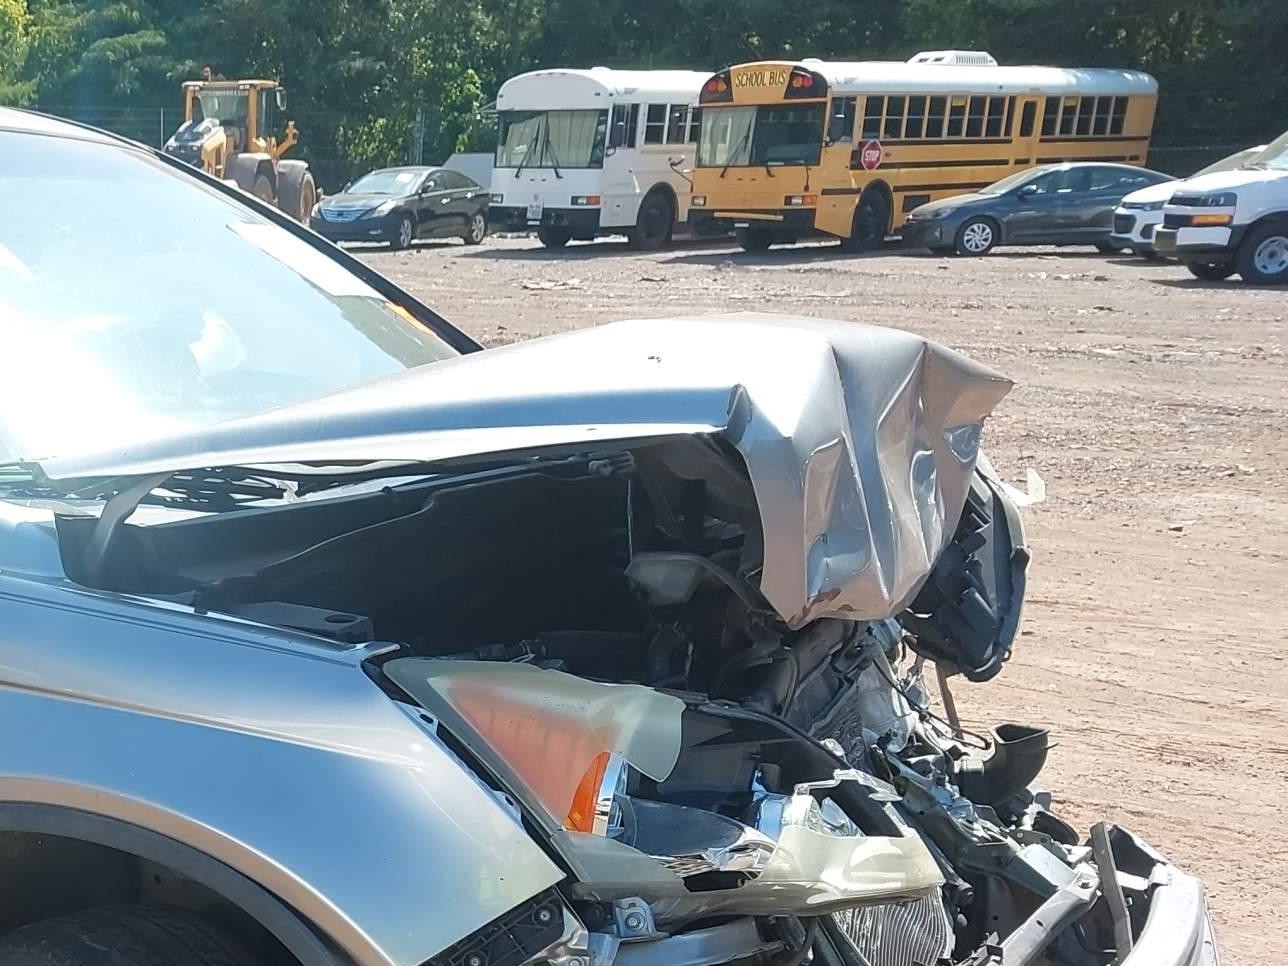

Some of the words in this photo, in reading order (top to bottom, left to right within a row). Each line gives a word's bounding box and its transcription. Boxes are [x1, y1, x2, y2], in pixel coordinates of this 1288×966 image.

[735, 71, 767, 88] SCHOOL
[768, 70, 787, 86] BUS
[864, 150, 880, 161] STOP
